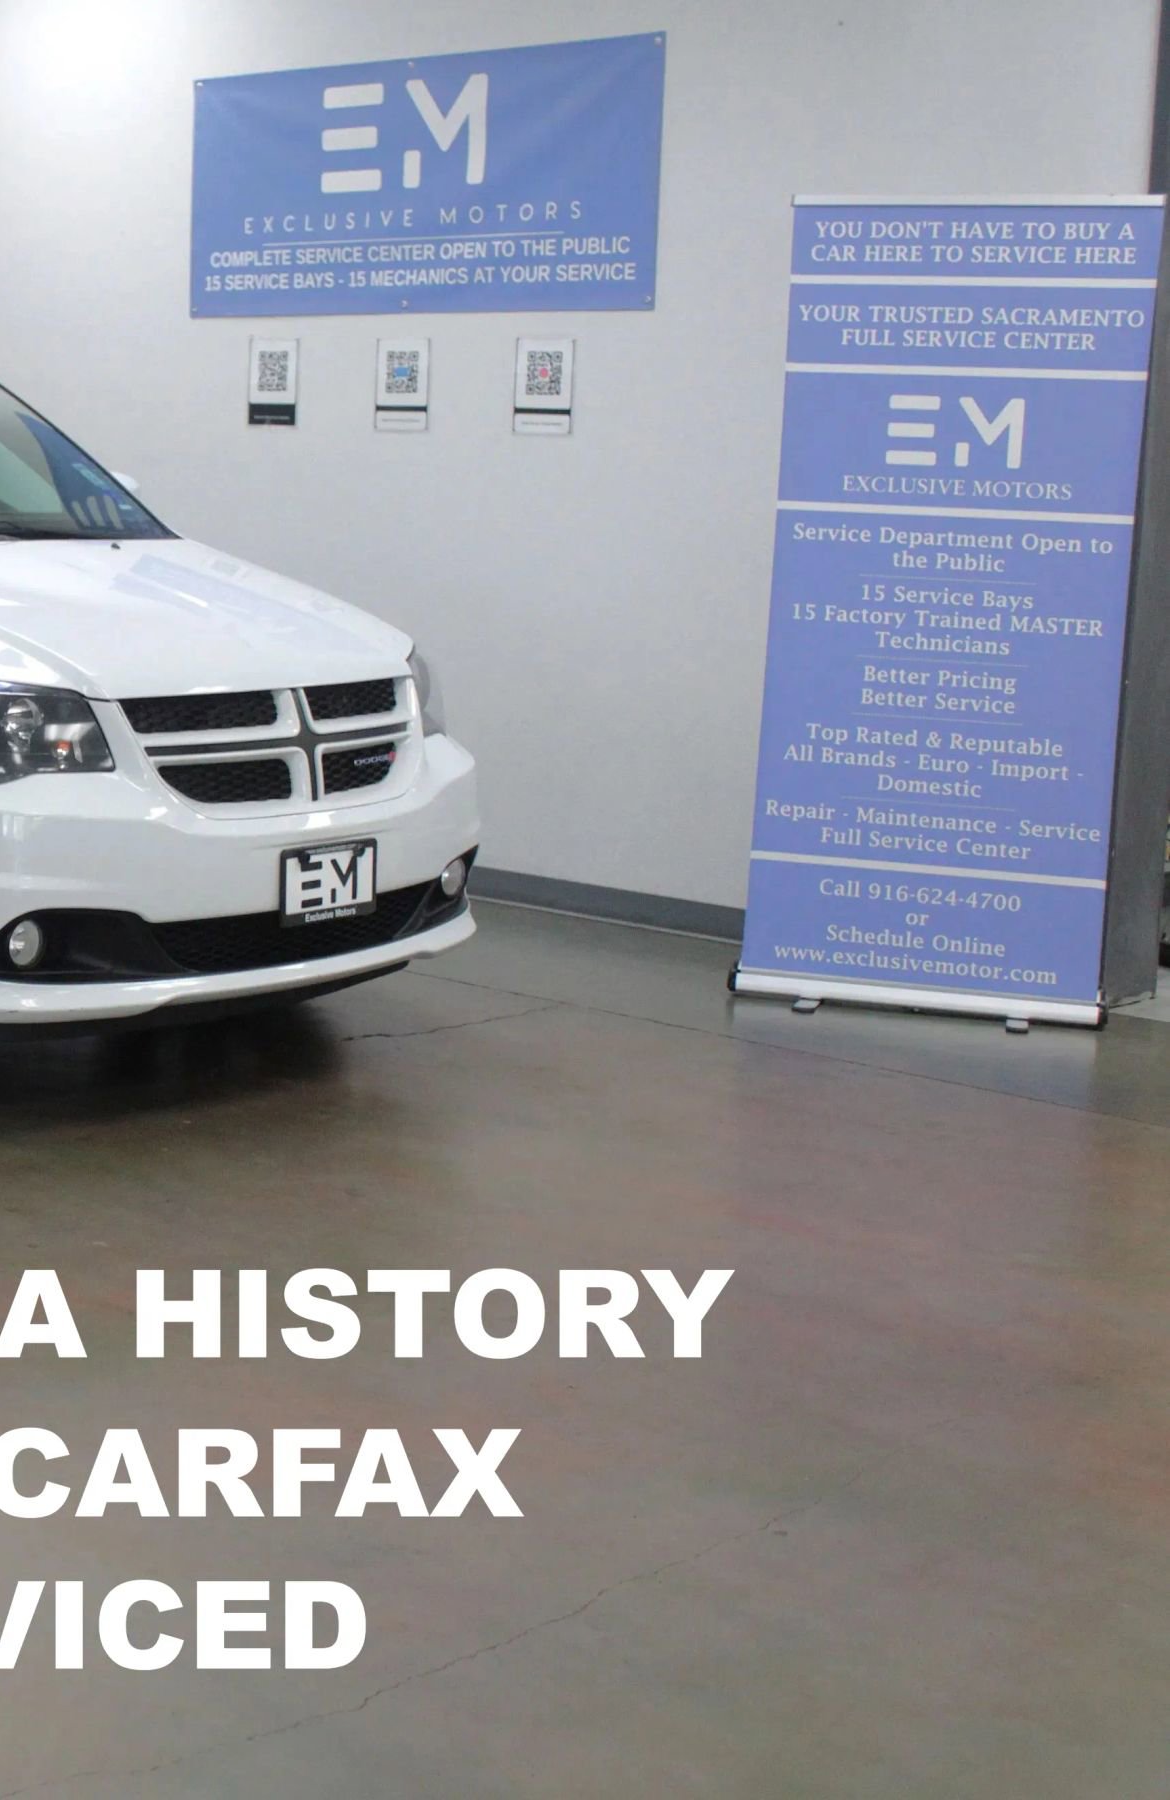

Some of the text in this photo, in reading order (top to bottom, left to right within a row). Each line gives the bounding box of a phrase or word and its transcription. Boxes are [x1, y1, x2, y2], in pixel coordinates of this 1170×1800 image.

[321, 74, 488, 193] EM
[245, 201, 580, 234] EXCLUSIVE MOTORS
[816, 221, 1134, 239] YOU DON'T HAVE TO BUY A
[211, 236, 630, 267] COMPLETE SERVICE CENTER OPEN TO THE PUBLIC
[812, 245, 1135, 264] CAR HERE TO SERVICE HERE
[205, 276, 221, 291] 15
[225, 274, 289, 290] SERVICE
[294, 272, 334, 288] BAYS
[349, 271, 366, 287] 15
[371, 267, 468, 286] MECHANICS
[474, 267, 495, 282] AT
[501, 265, 550, 282] YOUR
[557, 263, 635, 281] SERVICE
[800, 305, 1144, 327] YOUR TRUSTED SACRAMENTO
[842, 329, 1095, 350] FULL SERVICE CENTER
[886, 395, 1025, 468] EM
[844, 475, 1071, 499] EXCLUSIVE MOTORS
[794, 523, 1113, 554] Service Department Open to
[894, 551, 1004, 572] the Public
[862, 585, 1033, 611] 15 Service Bays
[794, 604, 1102, 636] 15 Factory Trained MASTER
[875, 632, 1009, 655] Technicians
[864, 666, 1016, 694] Better Pricing
[862, 689, 1015, 713] Better Service
[807, 724, 1062, 757] Top Rated & Reputable
[785, 745, 812, 761] All
[822, 747, 895, 767] Brands
[919, 754, 969, 773] Euro
[992, 760, 1068, 781] Import
[878, 774, 981, 797] Domestic
[766, 800, 835, 821] Repair
[856, 807, 997, 834] Maintenance
[1020, 820, 1100, 841] Service
[822, 827, 1031, 859] Full Service Center
[820, 879, 1021, 911] Call 916-624-4700
[906, 913, 929, 925] or
[827, 925, 1005, 957] Schedule Online
[774, 945, 1057, 985] www.exclusivemotor.com
